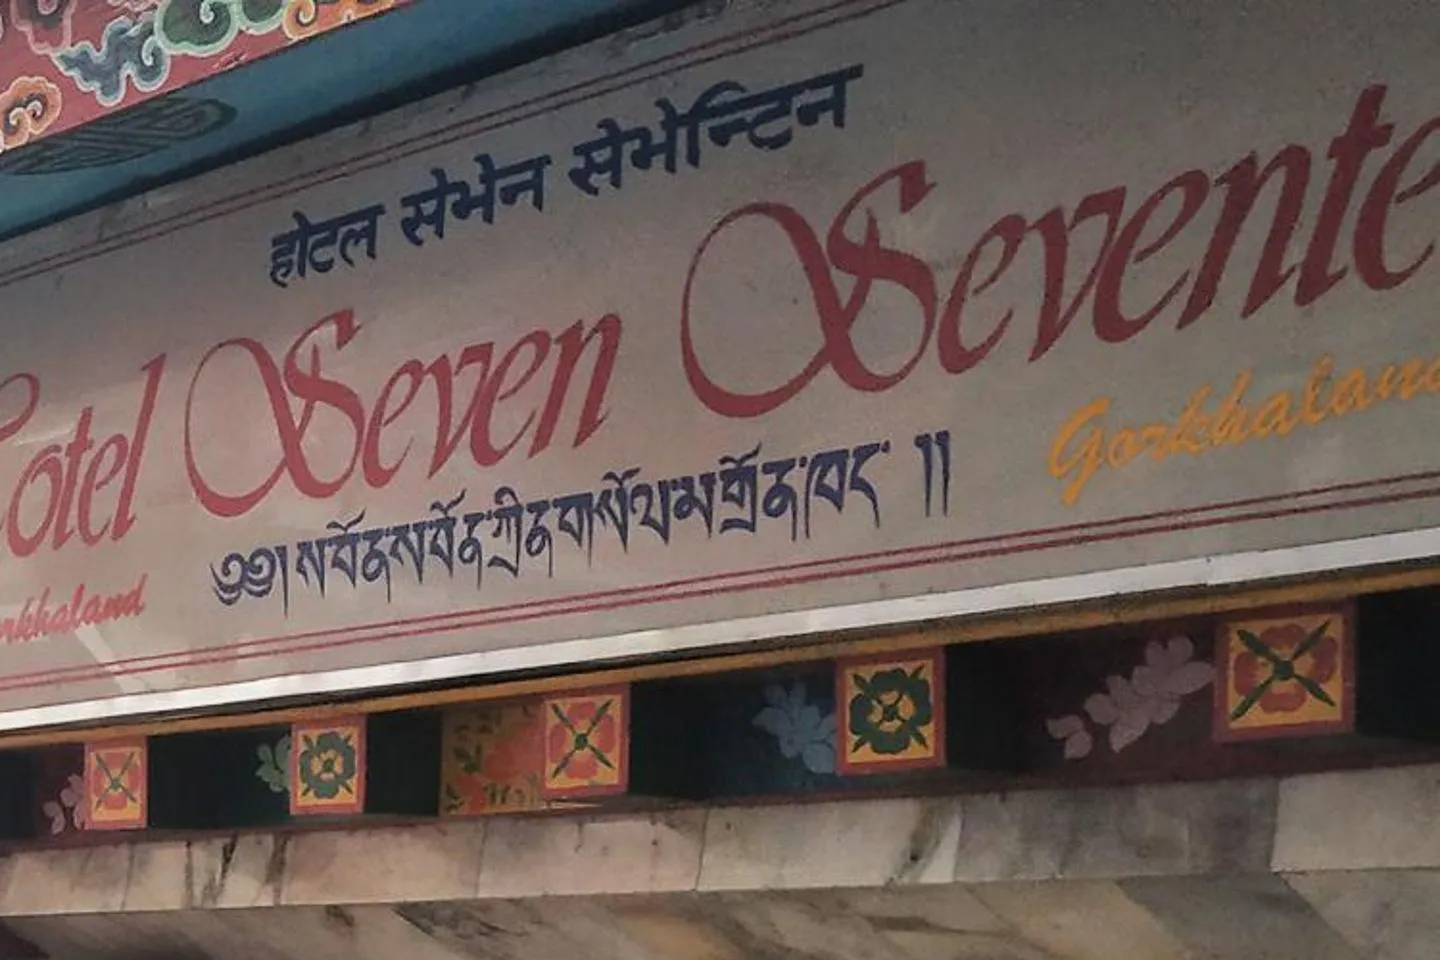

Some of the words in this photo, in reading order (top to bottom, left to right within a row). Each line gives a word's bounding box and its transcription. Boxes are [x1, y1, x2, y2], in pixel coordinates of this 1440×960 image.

[269, 204, 385, 287] होटल
[400, 153, 552, 246] सेभेन
[184, 307, 623, 518] Seven
